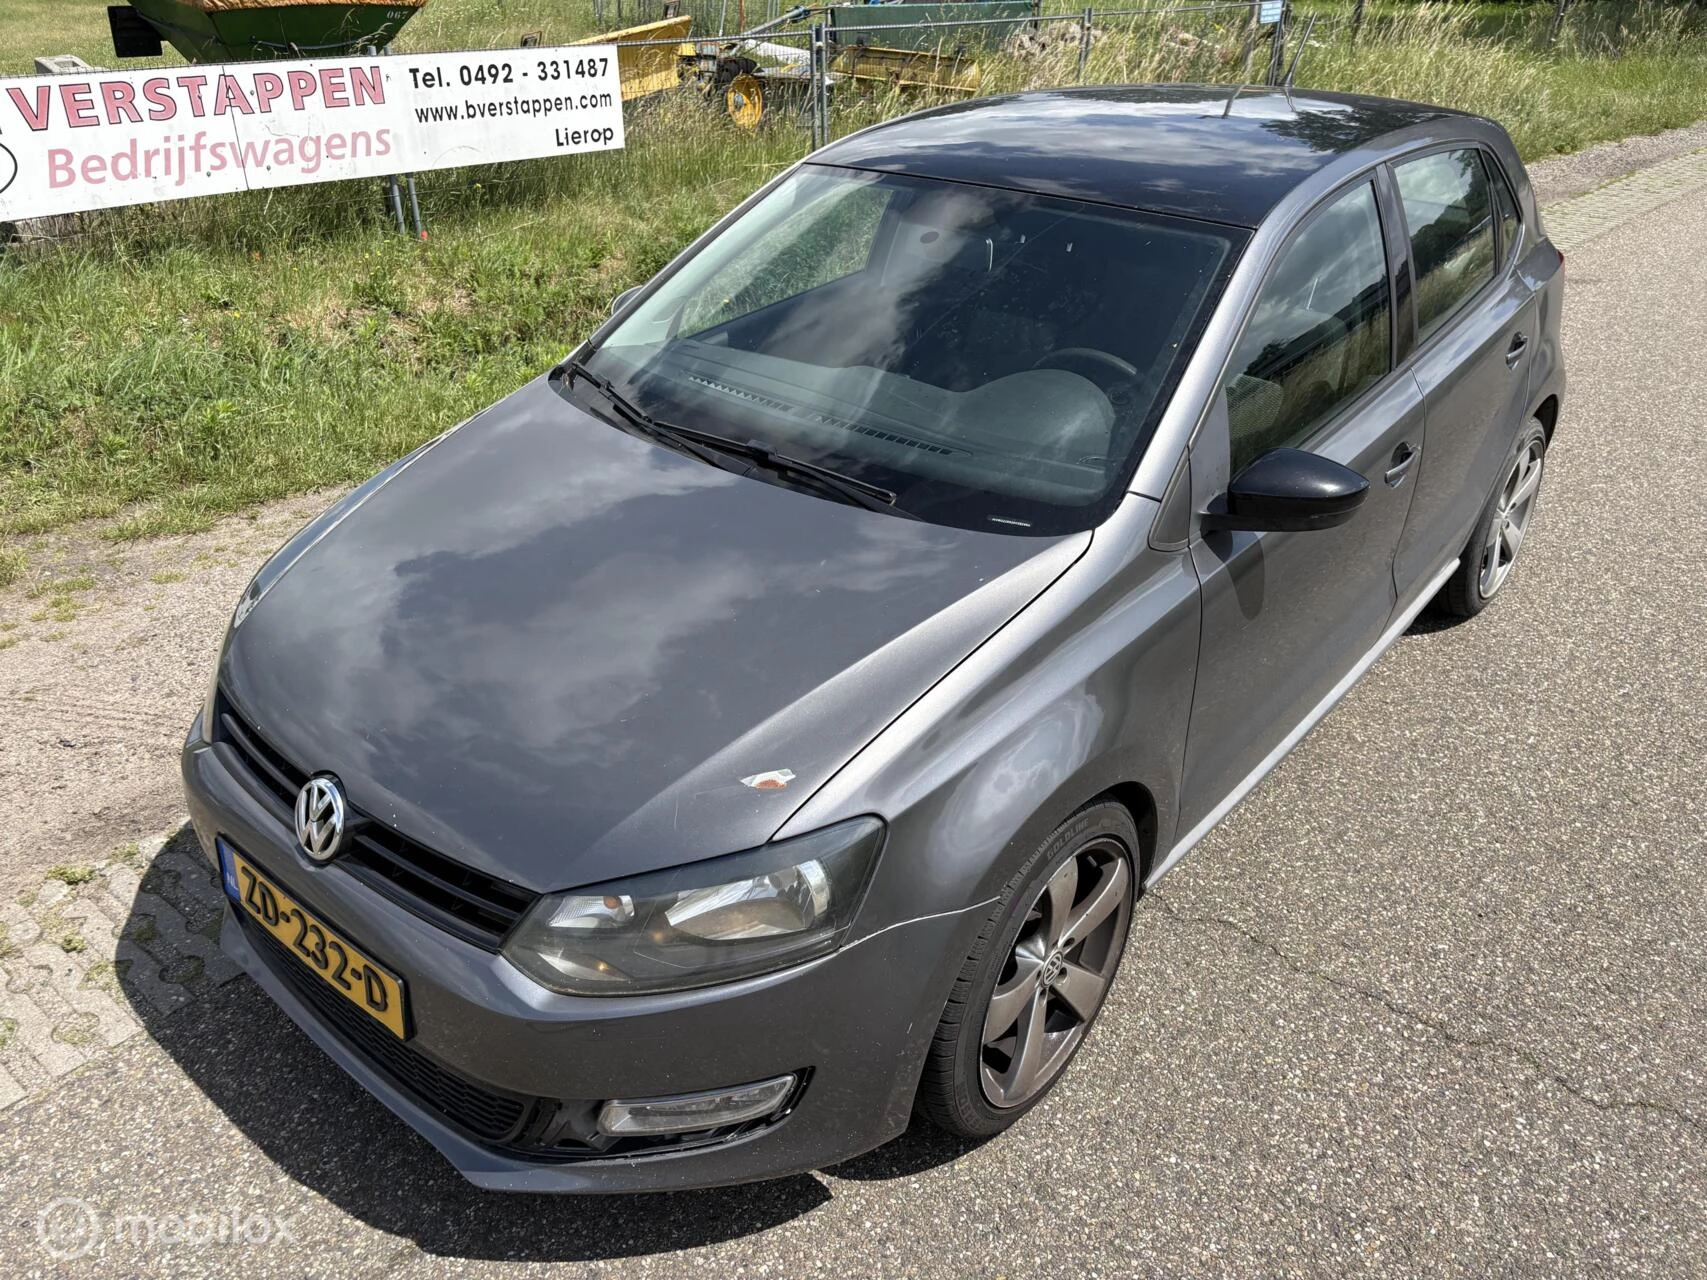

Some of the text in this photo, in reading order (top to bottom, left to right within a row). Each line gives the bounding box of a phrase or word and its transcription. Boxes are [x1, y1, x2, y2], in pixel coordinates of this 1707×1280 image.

[409, 67, 450, 89] Tel.
[459, 63, 514, 86] 0492
[537, 57, 608, 81] 331487
[6, 65, 386, 132] VERSTAPPEN
[415, 93, 612, 123] www.bverstappen.com
[48, 128, 391, 189] Bedrijfswagens
[555, 127, 614, 147] Lierop
[241, 866, 388, 1012] ZD-232-D
